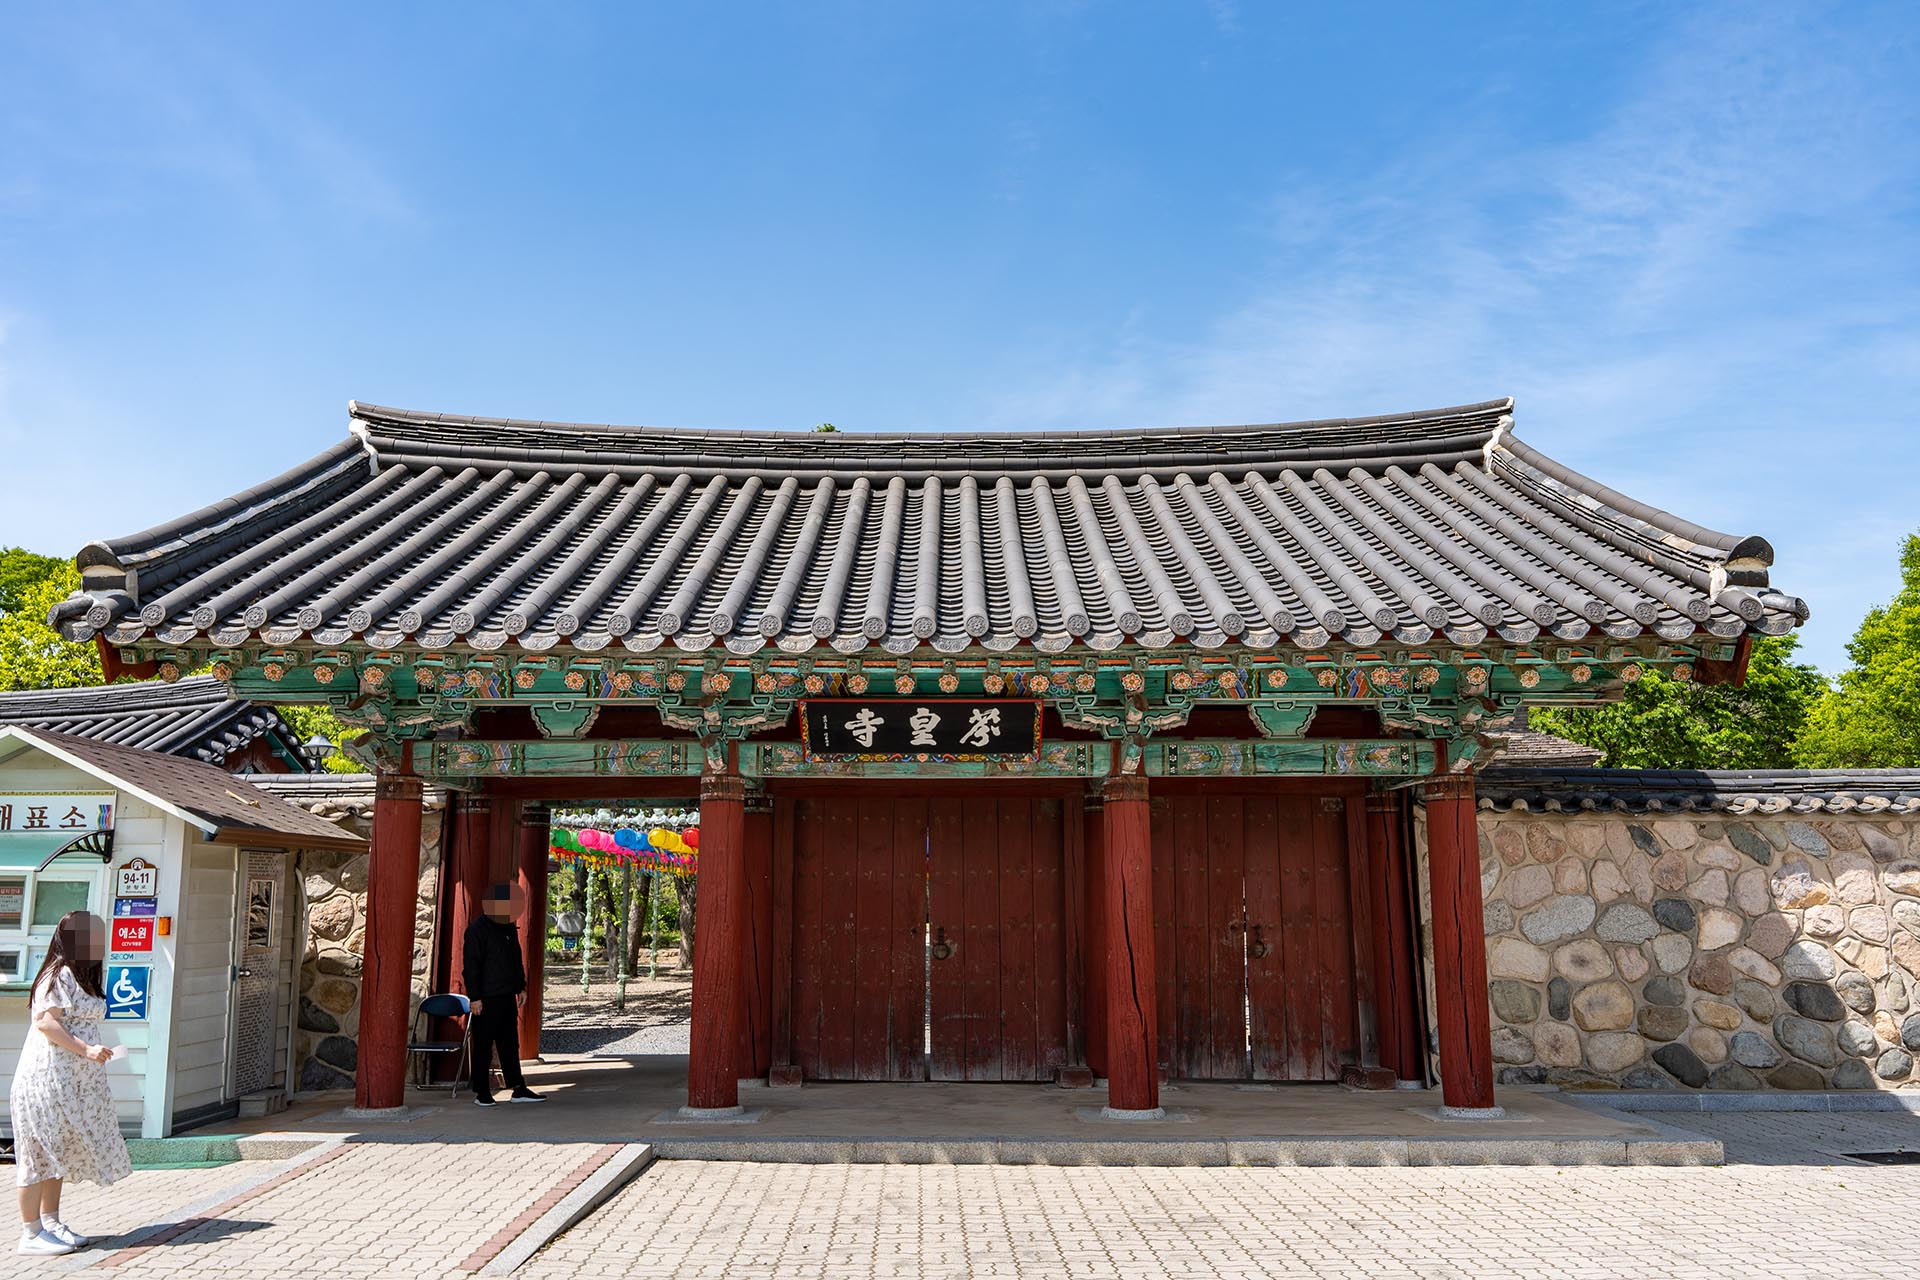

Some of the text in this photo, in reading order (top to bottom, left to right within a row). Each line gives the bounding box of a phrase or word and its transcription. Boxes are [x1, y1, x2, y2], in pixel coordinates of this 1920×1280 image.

[123, 872, 150, 884] 94-11
[118, 927, 147, 939] 에스원
[110, 953, 134, 961] SECOM
